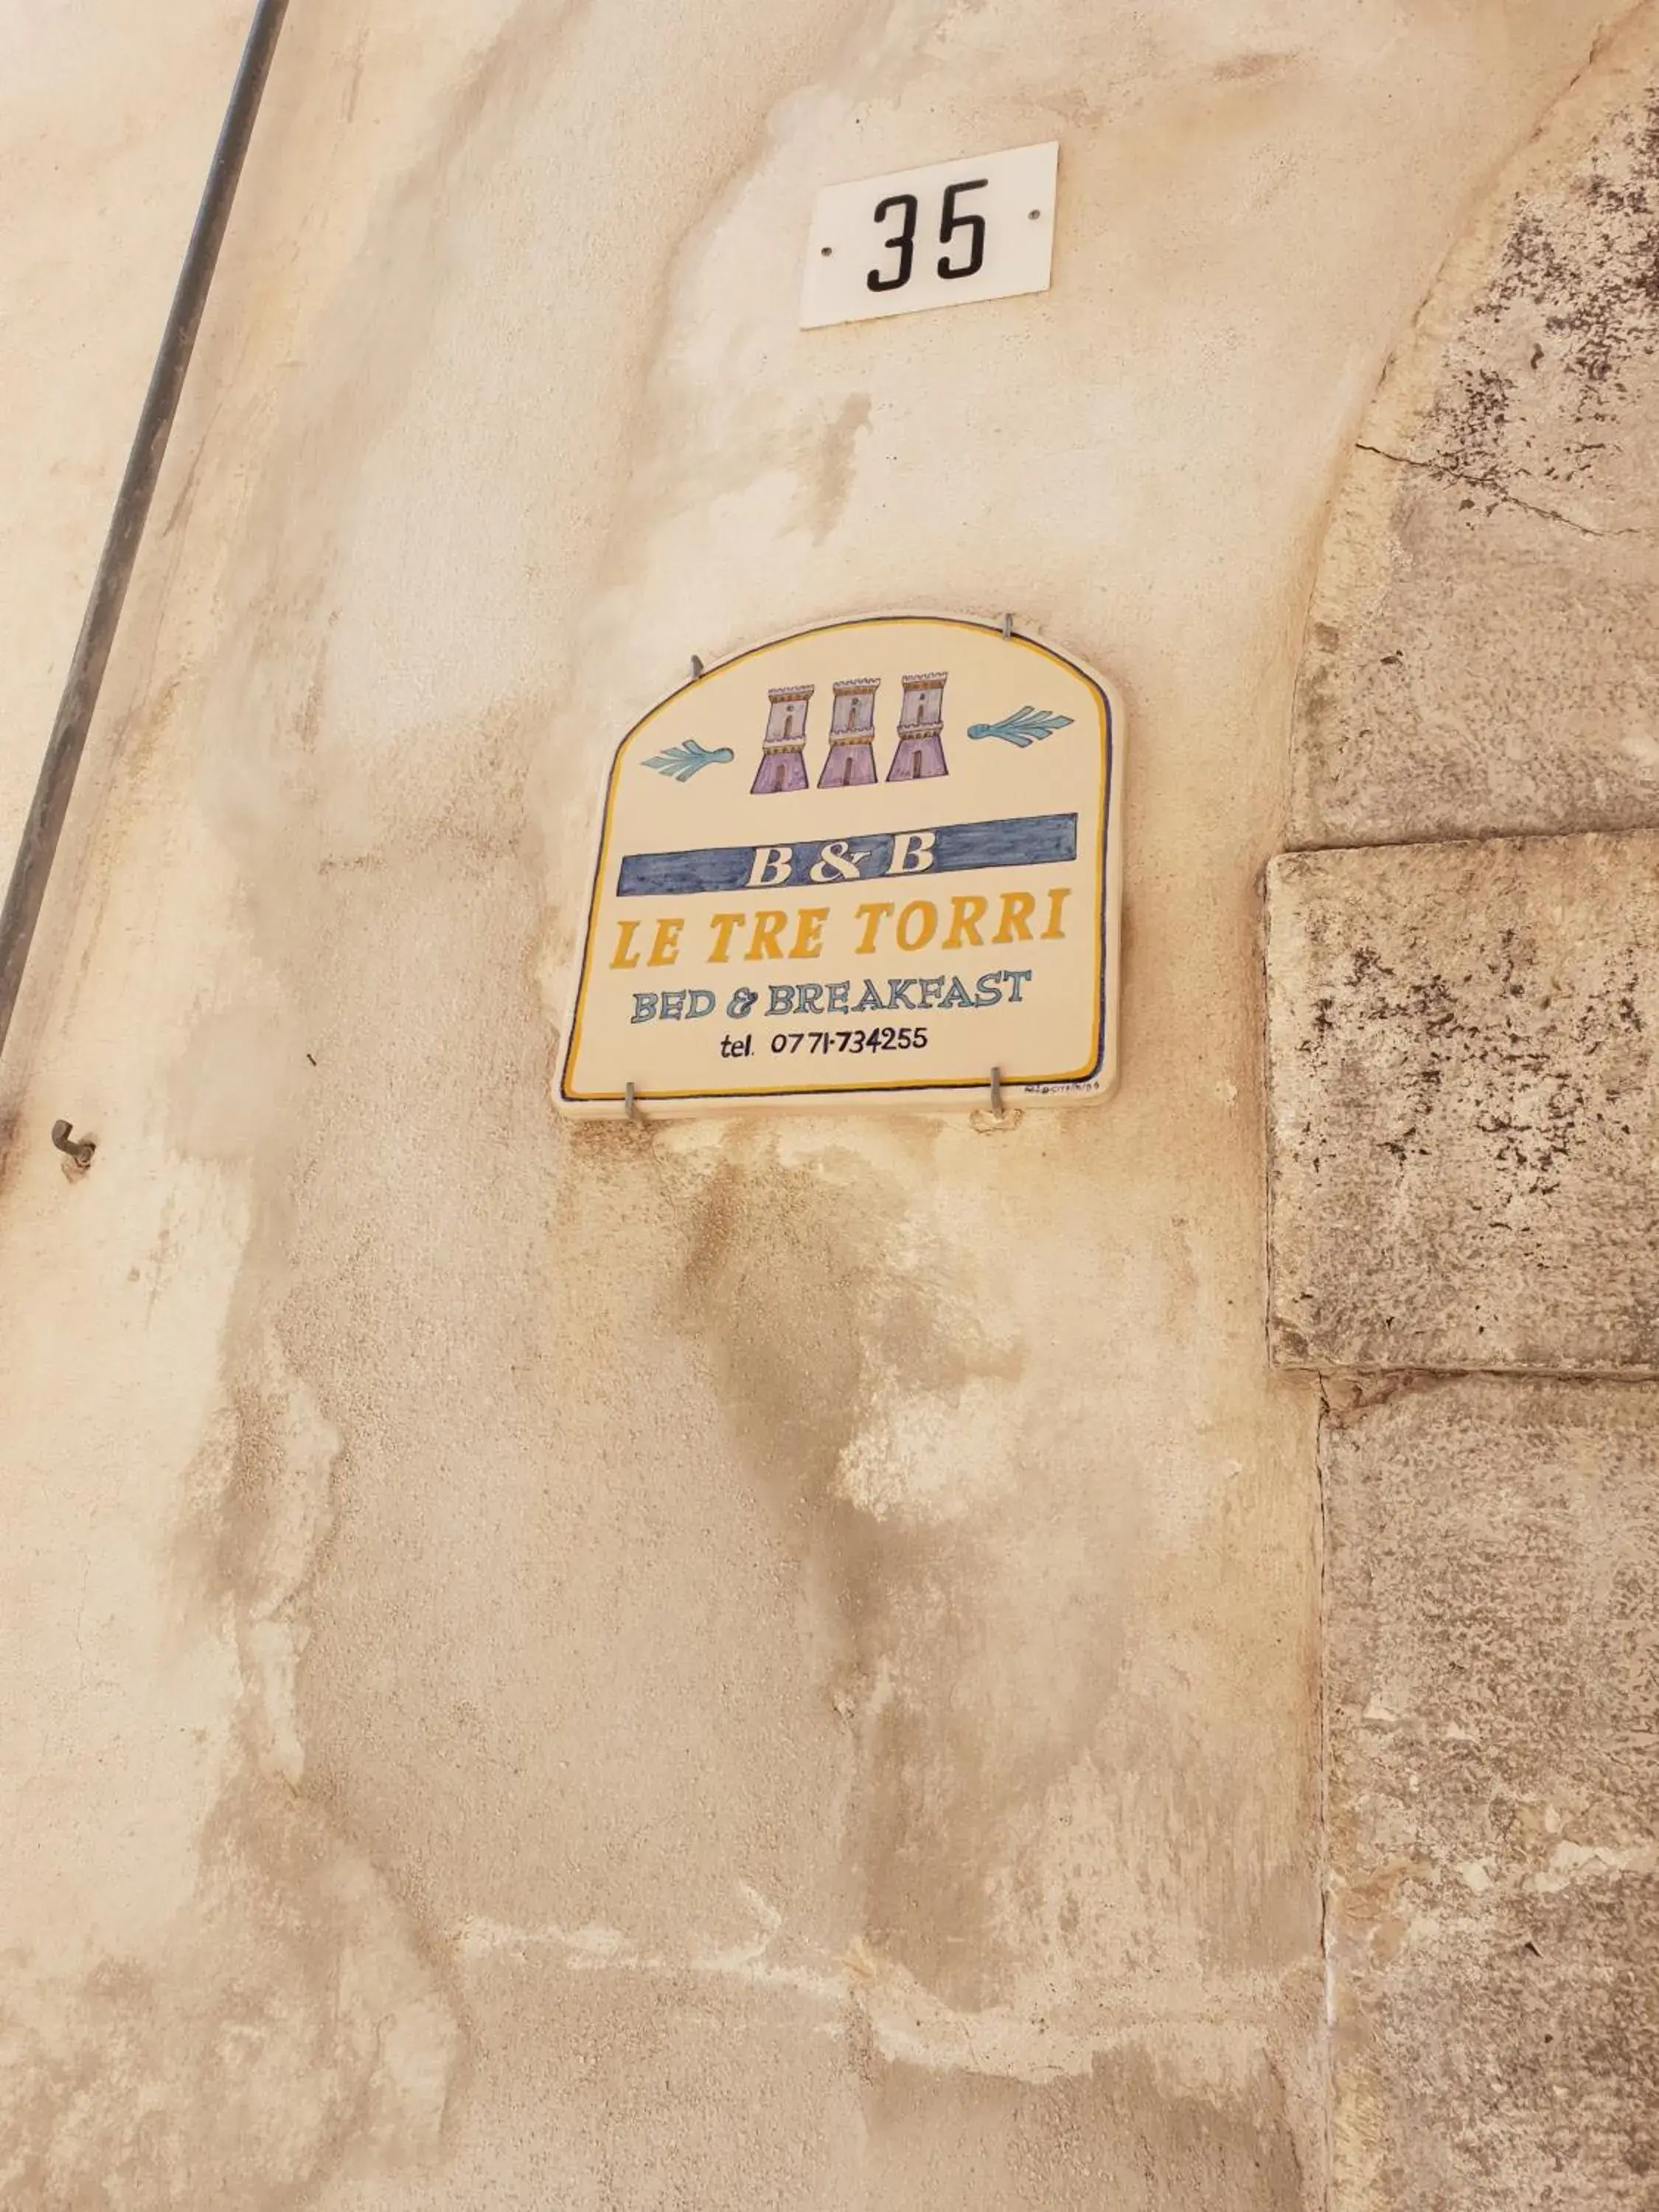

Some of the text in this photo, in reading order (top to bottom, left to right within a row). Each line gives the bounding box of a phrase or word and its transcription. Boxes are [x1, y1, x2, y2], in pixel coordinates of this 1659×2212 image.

[867, 178, 989, 292] 35
[744, 831, 938, 887] B & B
[609, 887, 1071, 969] LE TRE TORRI
[630, 969, 1032, 1024] BED & BREAKFAST
[720, 1034, 755, 1058] tel.
